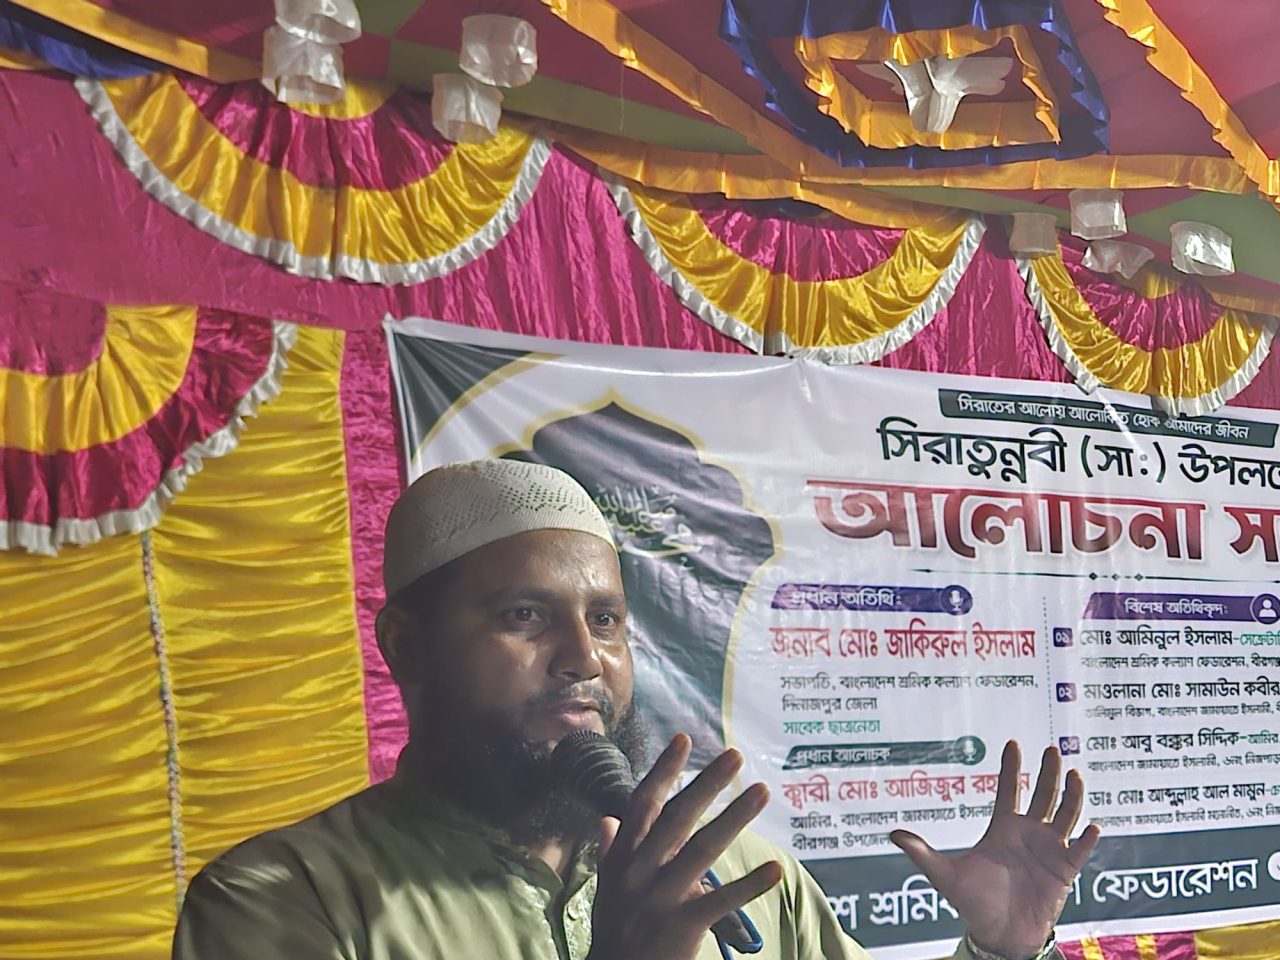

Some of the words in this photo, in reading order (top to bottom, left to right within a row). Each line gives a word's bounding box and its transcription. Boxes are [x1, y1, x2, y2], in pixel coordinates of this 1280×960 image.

[958, 394, 1016, 414] সিরাতের
[1018, 402, 1066, 419] আলোয়
[1133, 412, 1160, 428] হোক
[1215, 420, 1249, 440] জীবন
[876, 416, 1067, 483] সিরাতুন্নবী
[806, 480, 1206, 562] আলোচনা
[1124, 597, 1163, 614] বিশেষ
[769, 628, 831, 658] জনাব
[839, 629, 878, 657] মোঃ
[884, 618, 967, 658] জাকিরুল
[972, 622, 1035, 661] ইসলাম
[1080, 630, 1111, 646] মোঃ
[1117, 624, 1180, 650] আমিনুল
[839, 675, 896, 690] বাংলাদেশ
[898, 671, 932, 689] শ্রমিক
[1084, 683, 1146, 699] মাওলানা
[1152, 683, 1181, 699] মোঃ
[1185, 678, 1240, 697] সামাউন
[782, 694, 841, 714] দিনাজপুর
[845, 696, 878, 711] জেলা
[783, 721, 824, 735] সাবেক
[828, 719, 880, 736] ছাত্রনেতা
[835, 747, 892, 762] আলোচক
[1086, 736, 1117, 751] মোঃ
[1121, 735, 1153, 753] আবু
[838, 780, 878, 800] মোঃ
[884, 770, 965, 802] আজিজুর
[971, 773, 1030, 793] রহন
[1088, 791, 1113, 806] ডাঃ
[1118, 790, 1144, 805] মোঃ
[1202, 785, 1229, 799] আল
[840, 811, 898, 827] বাংলাদেশ
[901, 807, 956, 823] জামায়াতে
[792, 833, 839, 850] বীরগঞ্জ
[842, 831, 891, 848] উপজেল
[1092, 857, 1258, 903] ফেডারেশন
